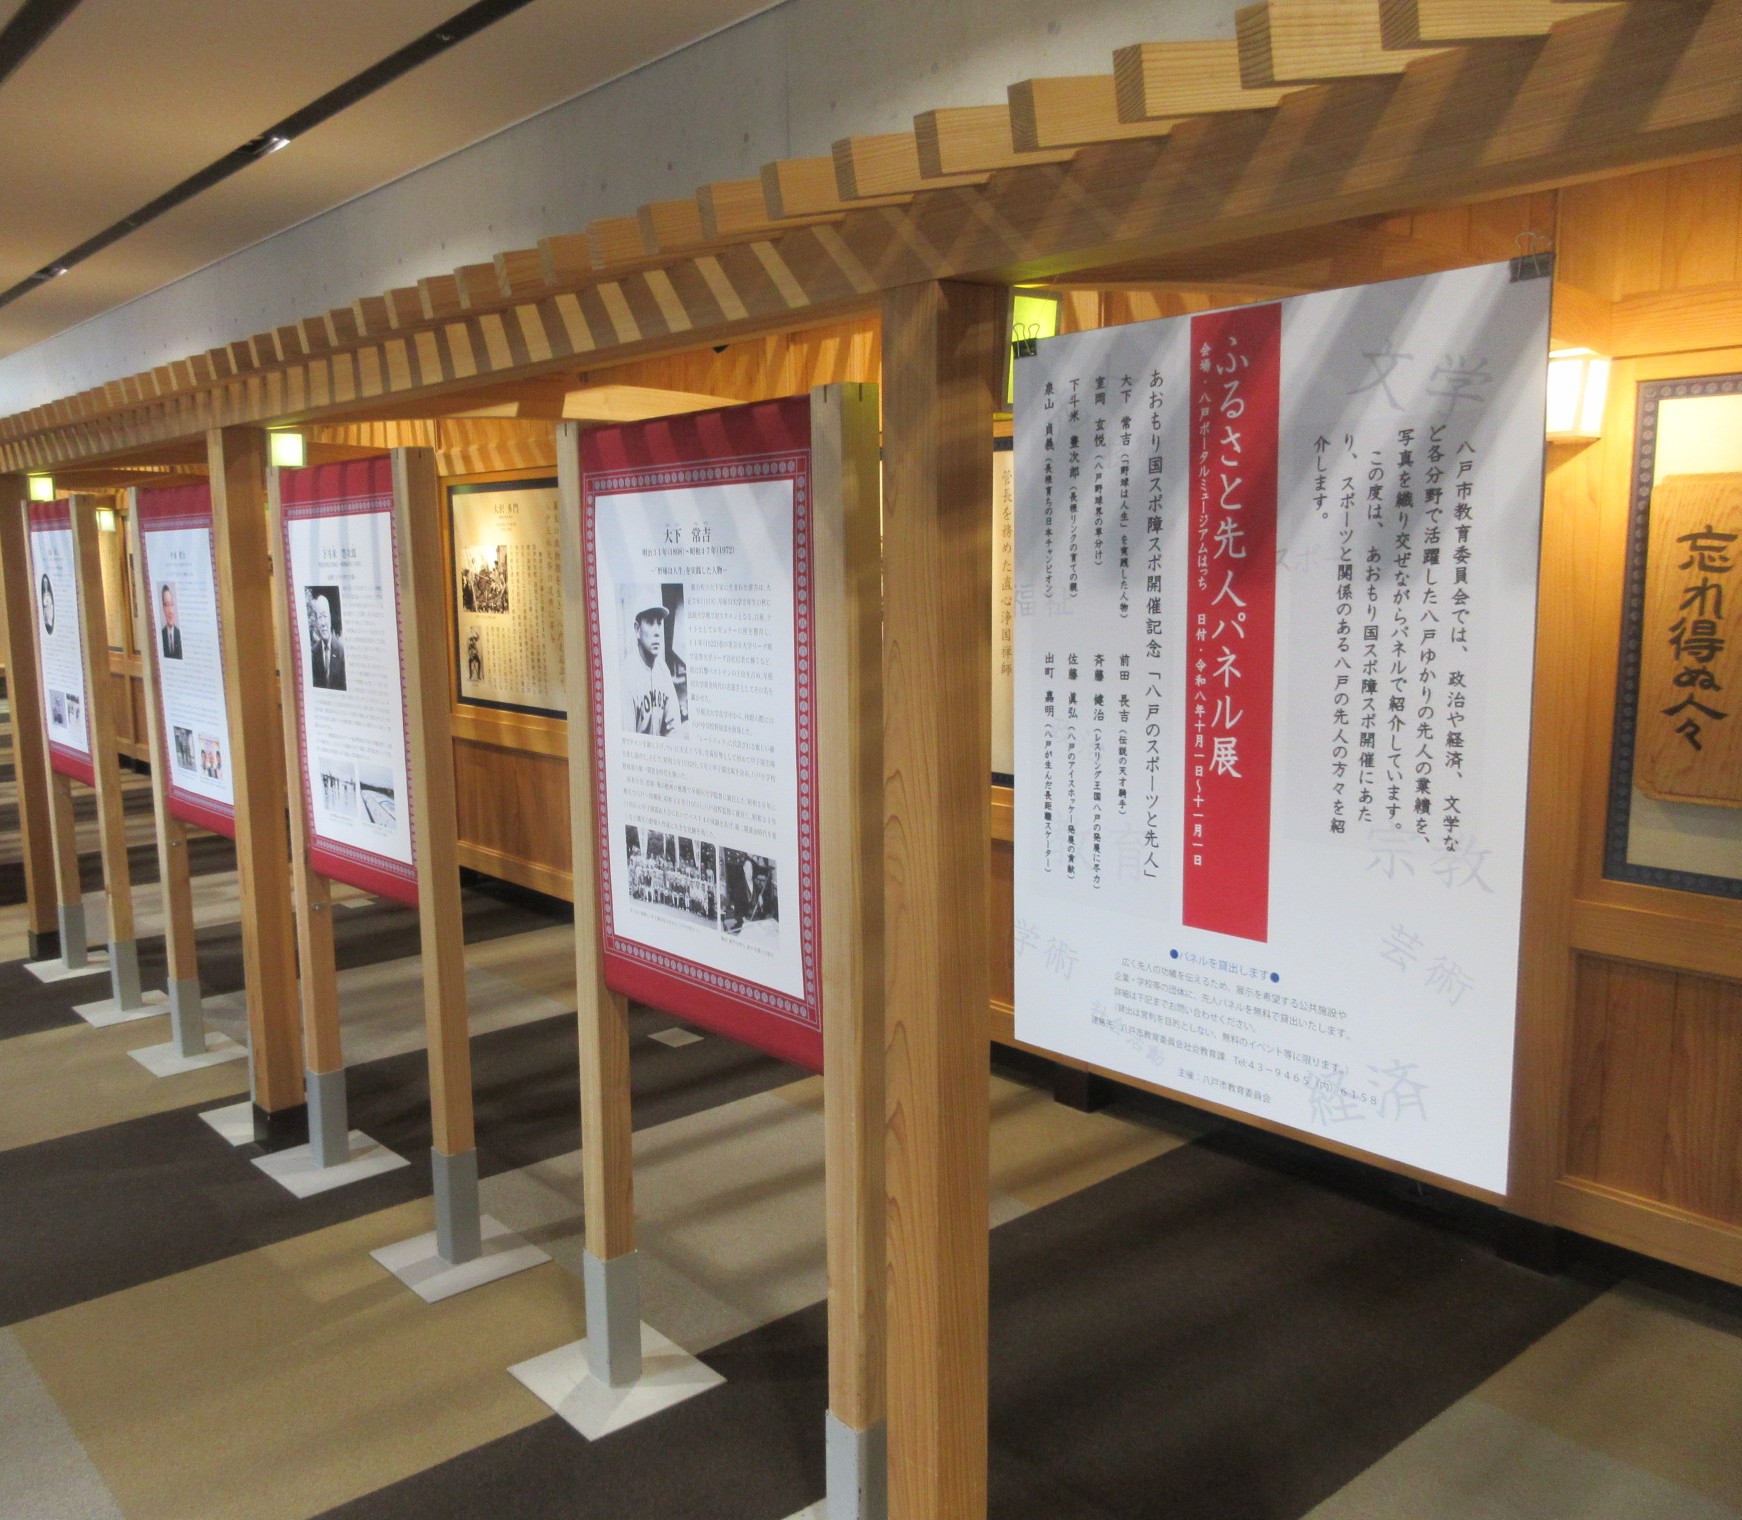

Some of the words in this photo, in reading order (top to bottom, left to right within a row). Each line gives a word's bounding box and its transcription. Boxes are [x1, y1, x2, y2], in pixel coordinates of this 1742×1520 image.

[1347, 340, 1498, 417] 文学
[1197, 342, 1212, 591] 会場・八戸ポータルミュージアムはっち
[1312, 435, 1330, 521] 介します。
[664, 528, 682, 545] 大下
[691, 527, 711, 544] 常吉
[1208, 335, 1249, 780] ふるさと先人パネル展
[1043, 652, 1055, 679] 出町
[1067, 653, 1079, 681] 佐藤
[1118, 654, 1131, 681] 前田
[1661, 525, 1738, 752] 忘れ得ぬ人々
[1380, 922, 1477, 1008] 芸術
